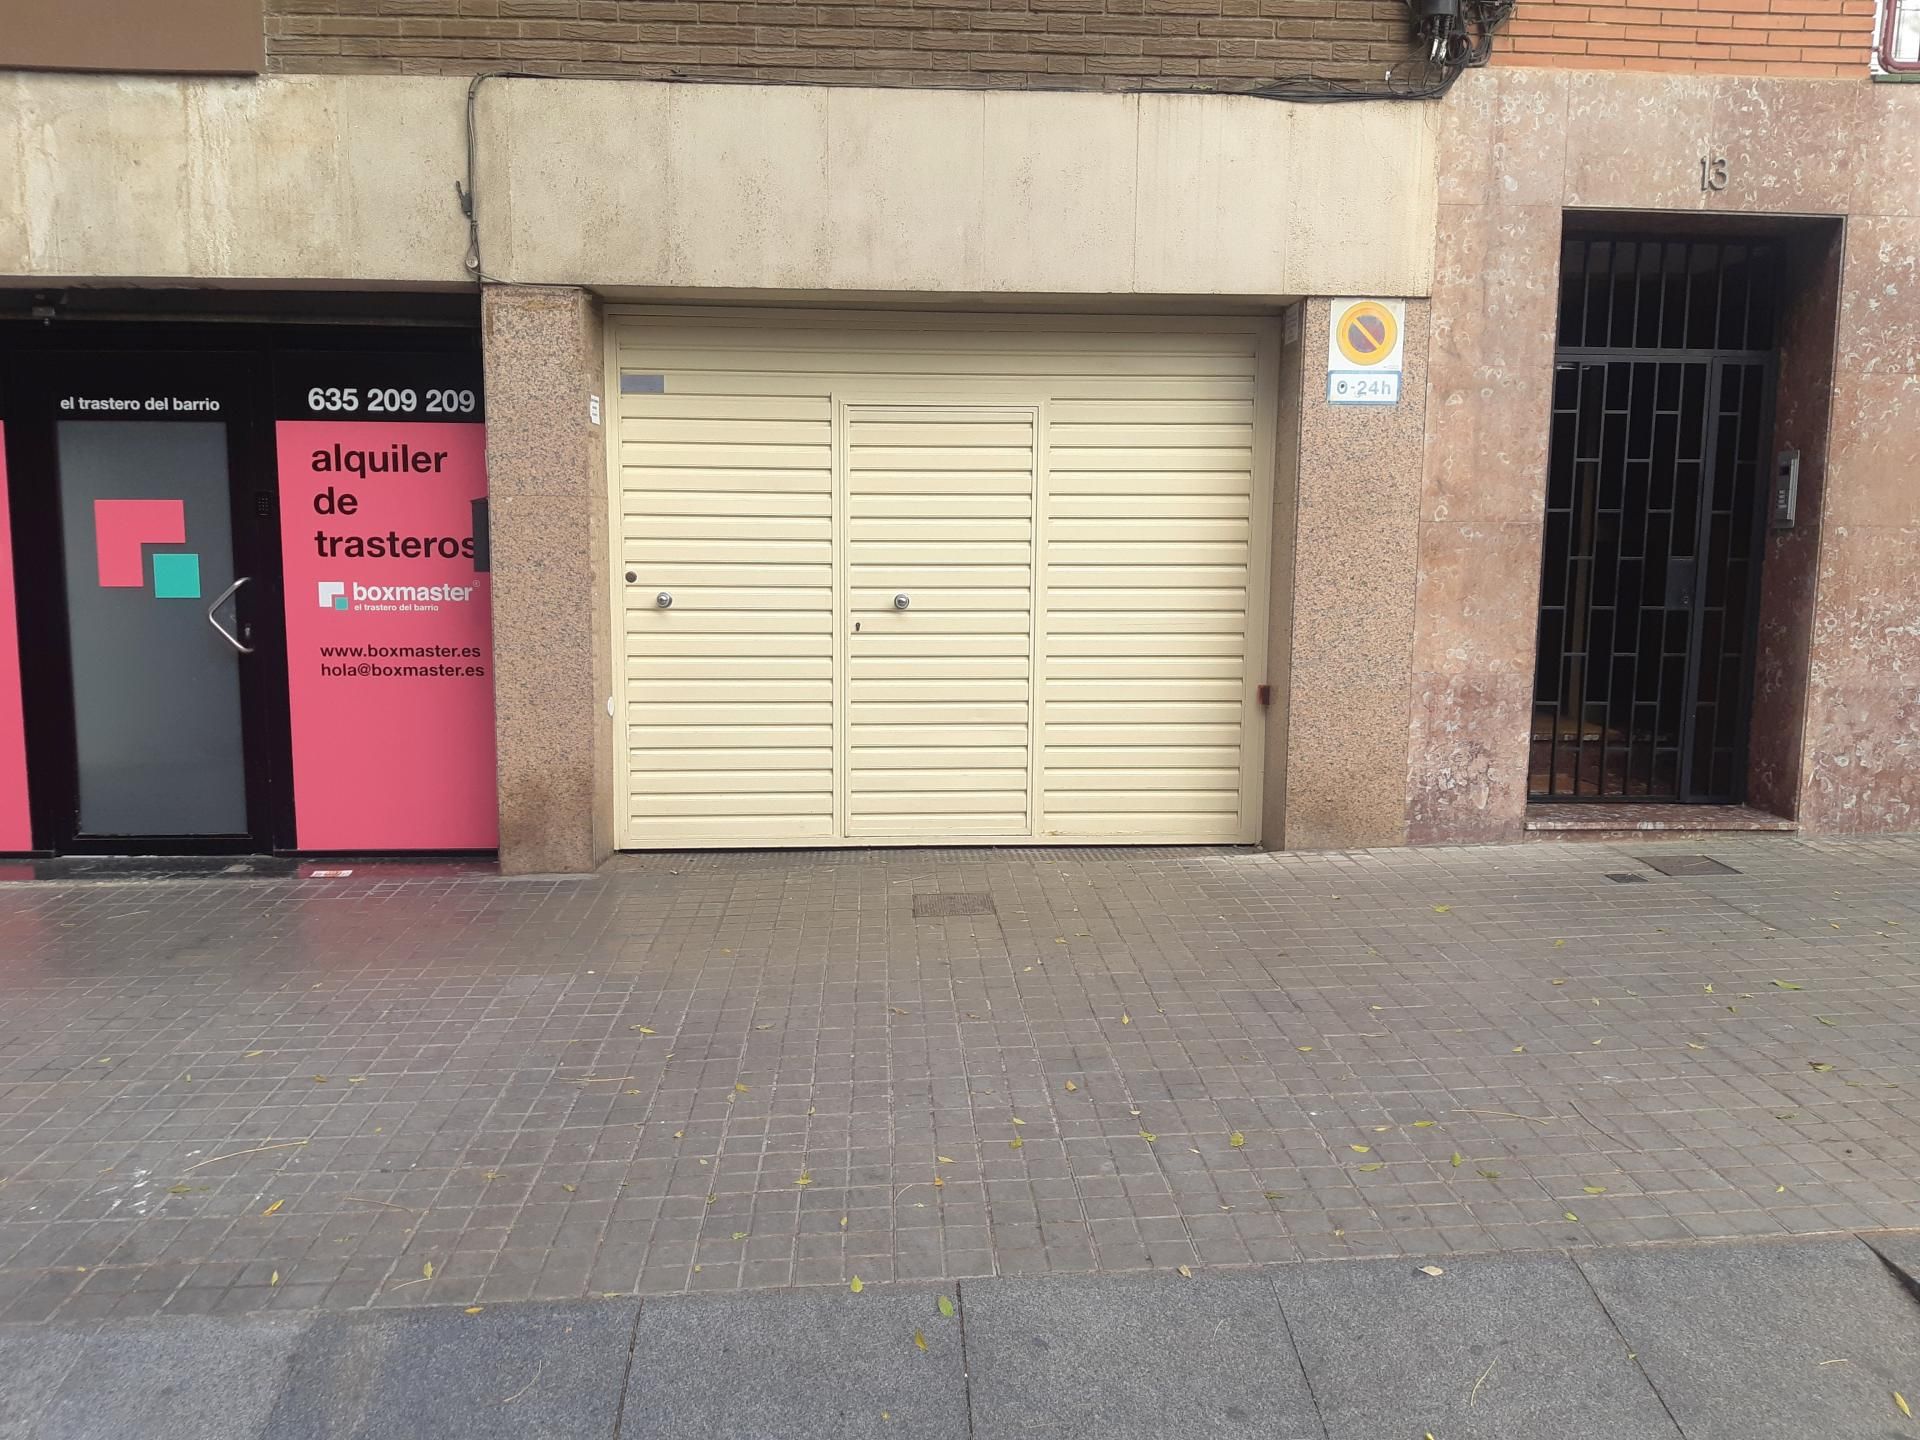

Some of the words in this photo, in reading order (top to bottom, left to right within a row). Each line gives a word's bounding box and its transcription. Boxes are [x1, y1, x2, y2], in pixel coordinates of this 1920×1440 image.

[1700, 156, 1729, 191] 13
[60, 396, 75, 410] el
[78, 397, 141, 410] trastero
[145, 397, 169, 411] del
[173, 397, 220, 411] barrio
[308, 387, 359, 411] 635
[367, 388, 418, 412] 209
[426, 389, 475, 413] 209
[311, 443, 448, 479] alquiler
[313, 486, 358, 515] de
[314, 531, 475, 559] trasteros
[354, 603, 362, 612] el
[364, 604, 397, 612] trastero
[399, 604, 412, 612] del
[414, 604, 439, 612] barrio
[320, 643, 481, 658] www.boxmaster.es
[321, 662, 485, 677] hola@boxmaster.es
